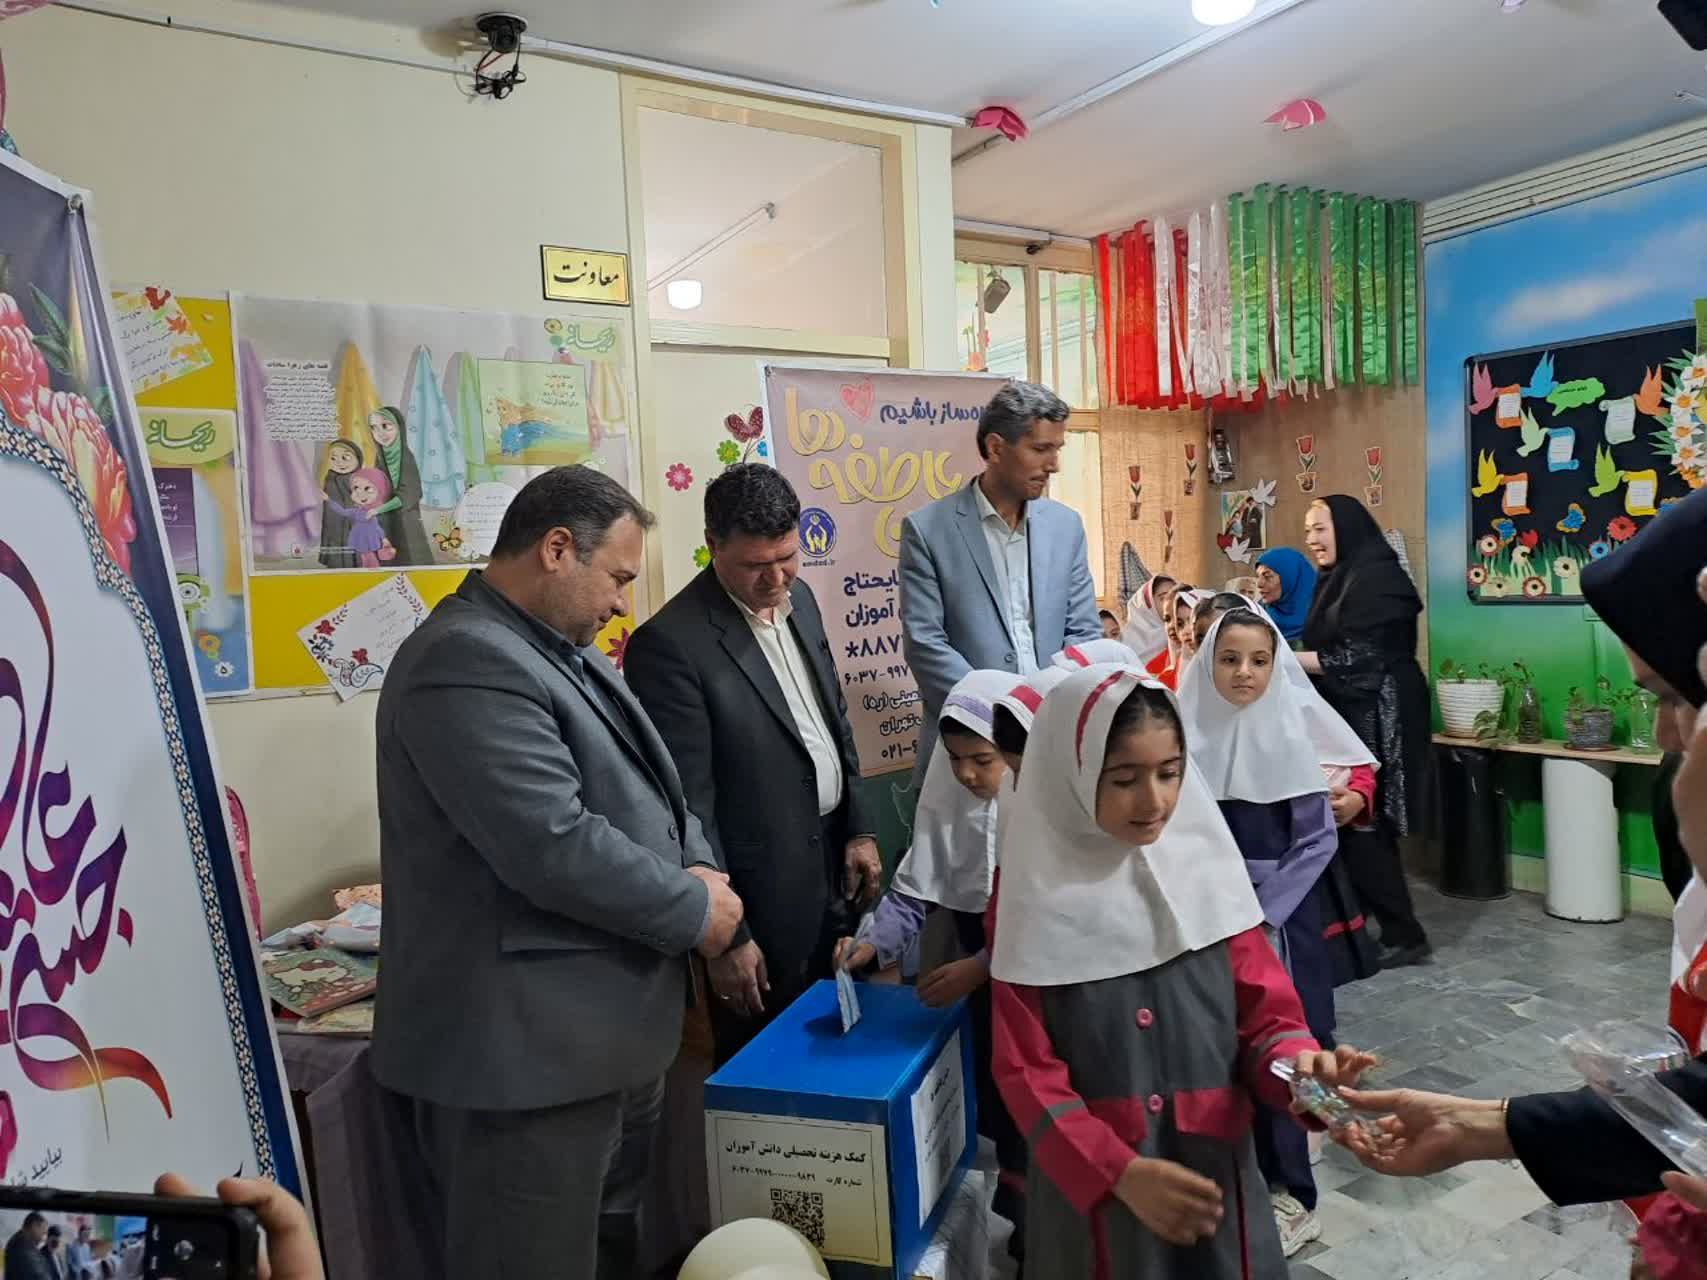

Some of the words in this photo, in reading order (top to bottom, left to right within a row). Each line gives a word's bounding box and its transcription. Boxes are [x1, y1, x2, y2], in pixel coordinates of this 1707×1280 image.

[553, 261, 619, 286] معاونت
[879, 397, 937, 425] باشیم
[146, 419, 216, 453] ریحانه
[844, 569, 900, 596] ایحتاج
[845, 598, 895, 628] آموزان
[845, 634, 904, 658] ۸۸۷
[890, 689, 920, 710] مینی
[881, 740, 919, 760] ۰۲۱-۶
[725, 1140, 756, 1154] آموزان
[758, 1143, 782, 1156] دانش
[844, 1151, 866, 1163] کمک
